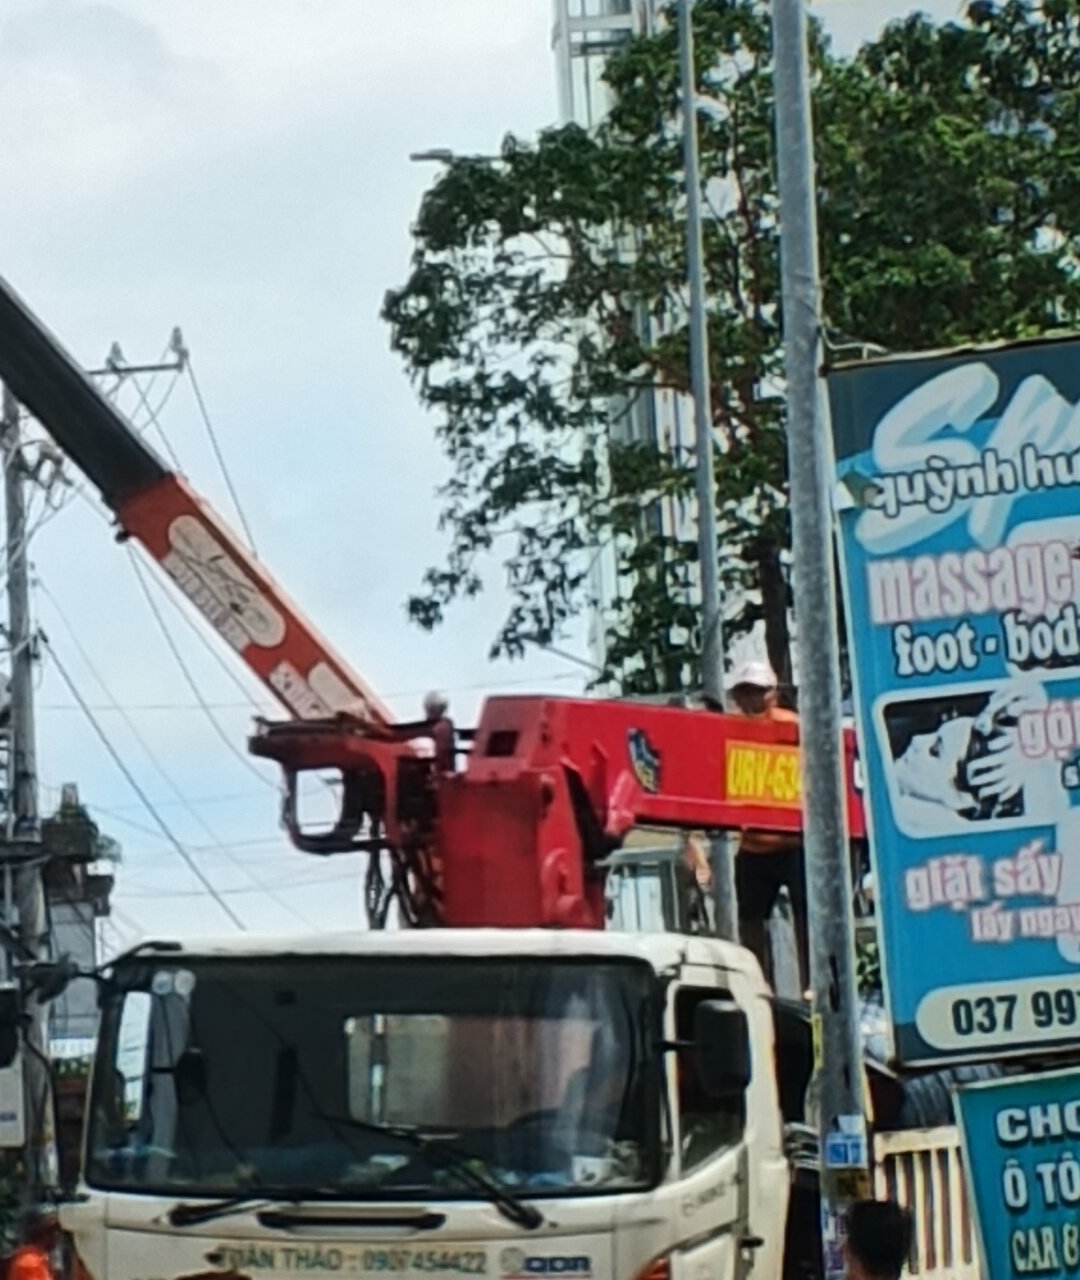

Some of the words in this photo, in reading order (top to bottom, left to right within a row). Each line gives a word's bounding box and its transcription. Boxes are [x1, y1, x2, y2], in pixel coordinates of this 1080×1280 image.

[867, 542, 1073, 624] massage
[893, 620, 979, 677] foot
[1003, 604, 1080, 664] bod
[992, 838, 1063, 899] sấy
[951, 993, 1017, 1036] 037
[1031, 988, 1080, 1028] 99
[1003, 1158, 1028, 1208] Ô
[1036, 1151, 1080, 1204] TÔ
[1012, 1225, 1059, 1272] CAR
